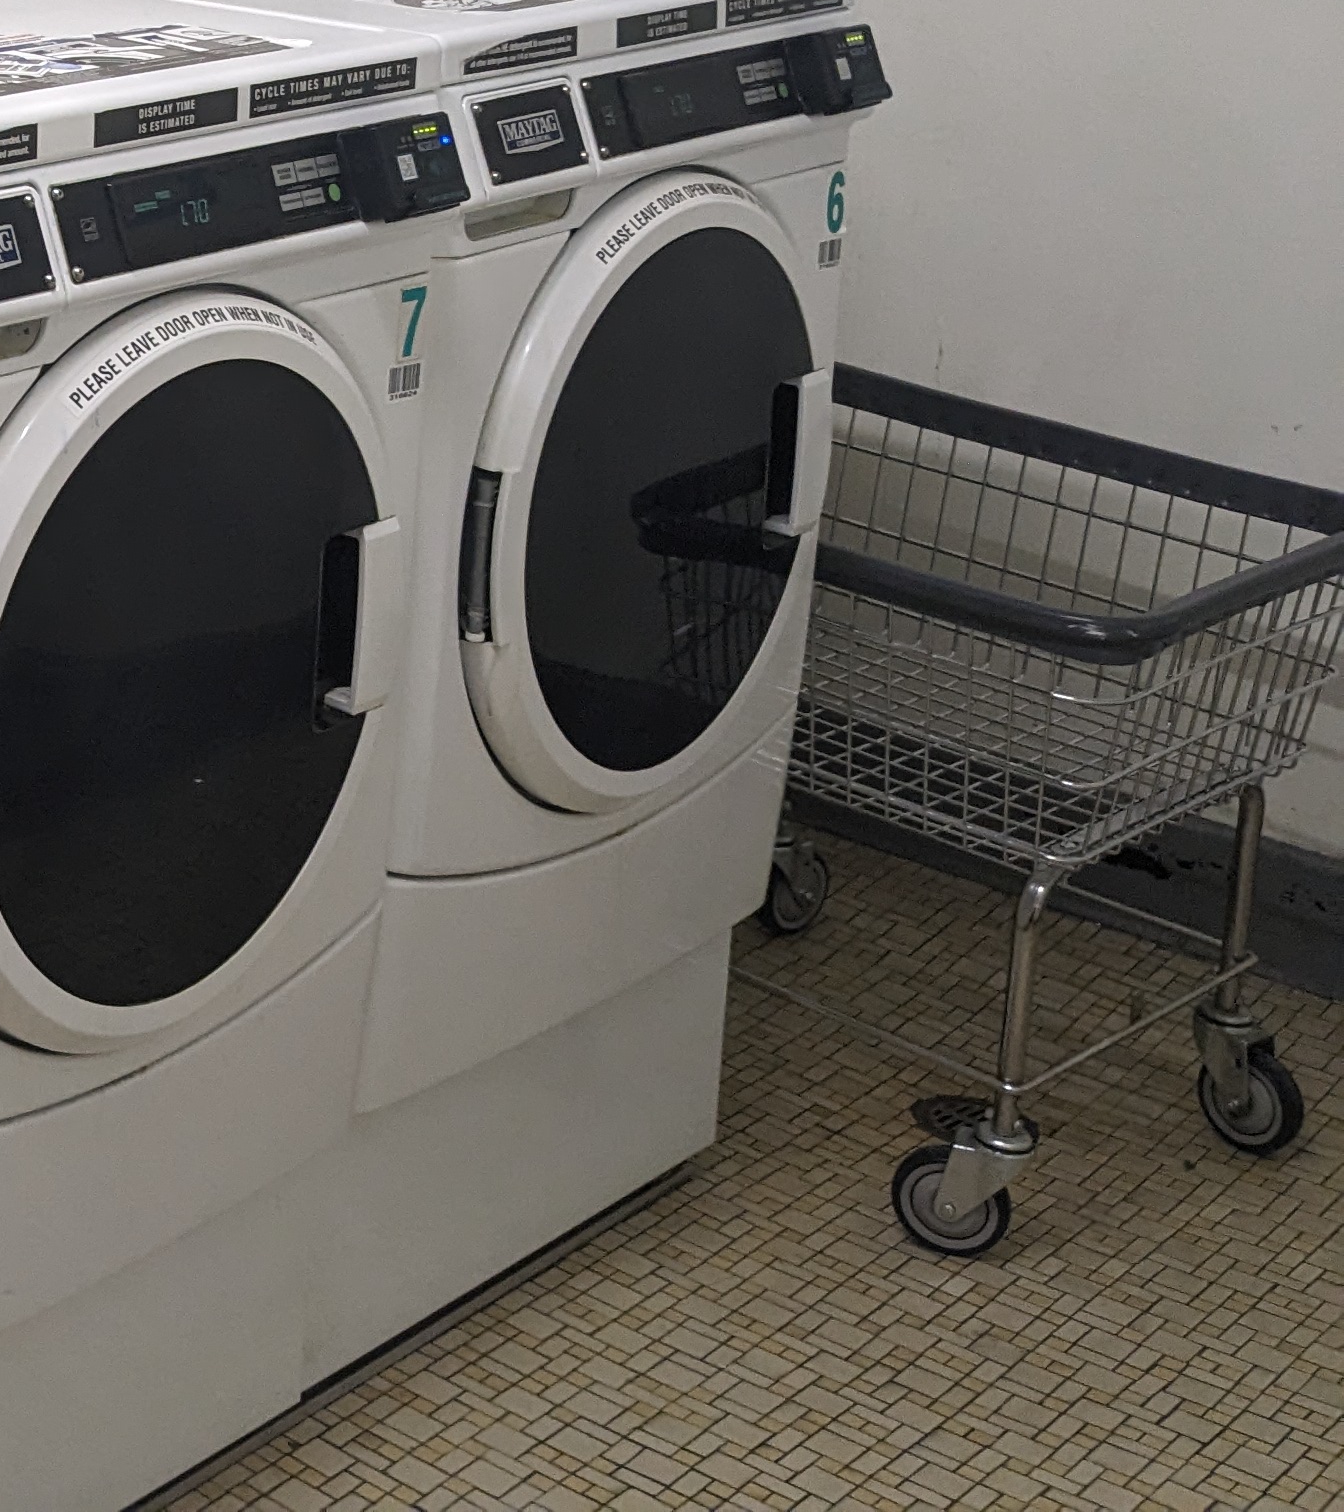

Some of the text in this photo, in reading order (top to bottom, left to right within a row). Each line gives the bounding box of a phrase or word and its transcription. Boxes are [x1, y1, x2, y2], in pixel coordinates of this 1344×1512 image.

[255, 85, 285, 100] CYCLE
[290, 78, 319, 94] TIMES
[323, 74, 343, 88] MAY
[347, 70, 371, 84] VARY
[375, 65, 392, 79] DUE
[138, 99, 196, 120] DISPLAY TIME
[138, 114, 195, 134] IS ESTIMATED
[503, 114, 559, 142] MAYTAG
[595, 223, 635, 265] PLEASE
[628, 202, 663, 231] LEAVE
[656, 188, 685, 211] DOOR
[682, 183, 708, 198] OPEN
[827, 171, 845, 234] 6
[402, 286, 427, 357] 7
[69, 358, 122, 409] PLEASE
[115, 331, 160, 367] LEAVE
[155, 314, 195, 342] DOOR
[192, 307, 228, 326] OPEN
[224, 305, 262, 323] WHEN
[261, 309, 288, 329] NOT
[283, 317, 299, 333] IN
